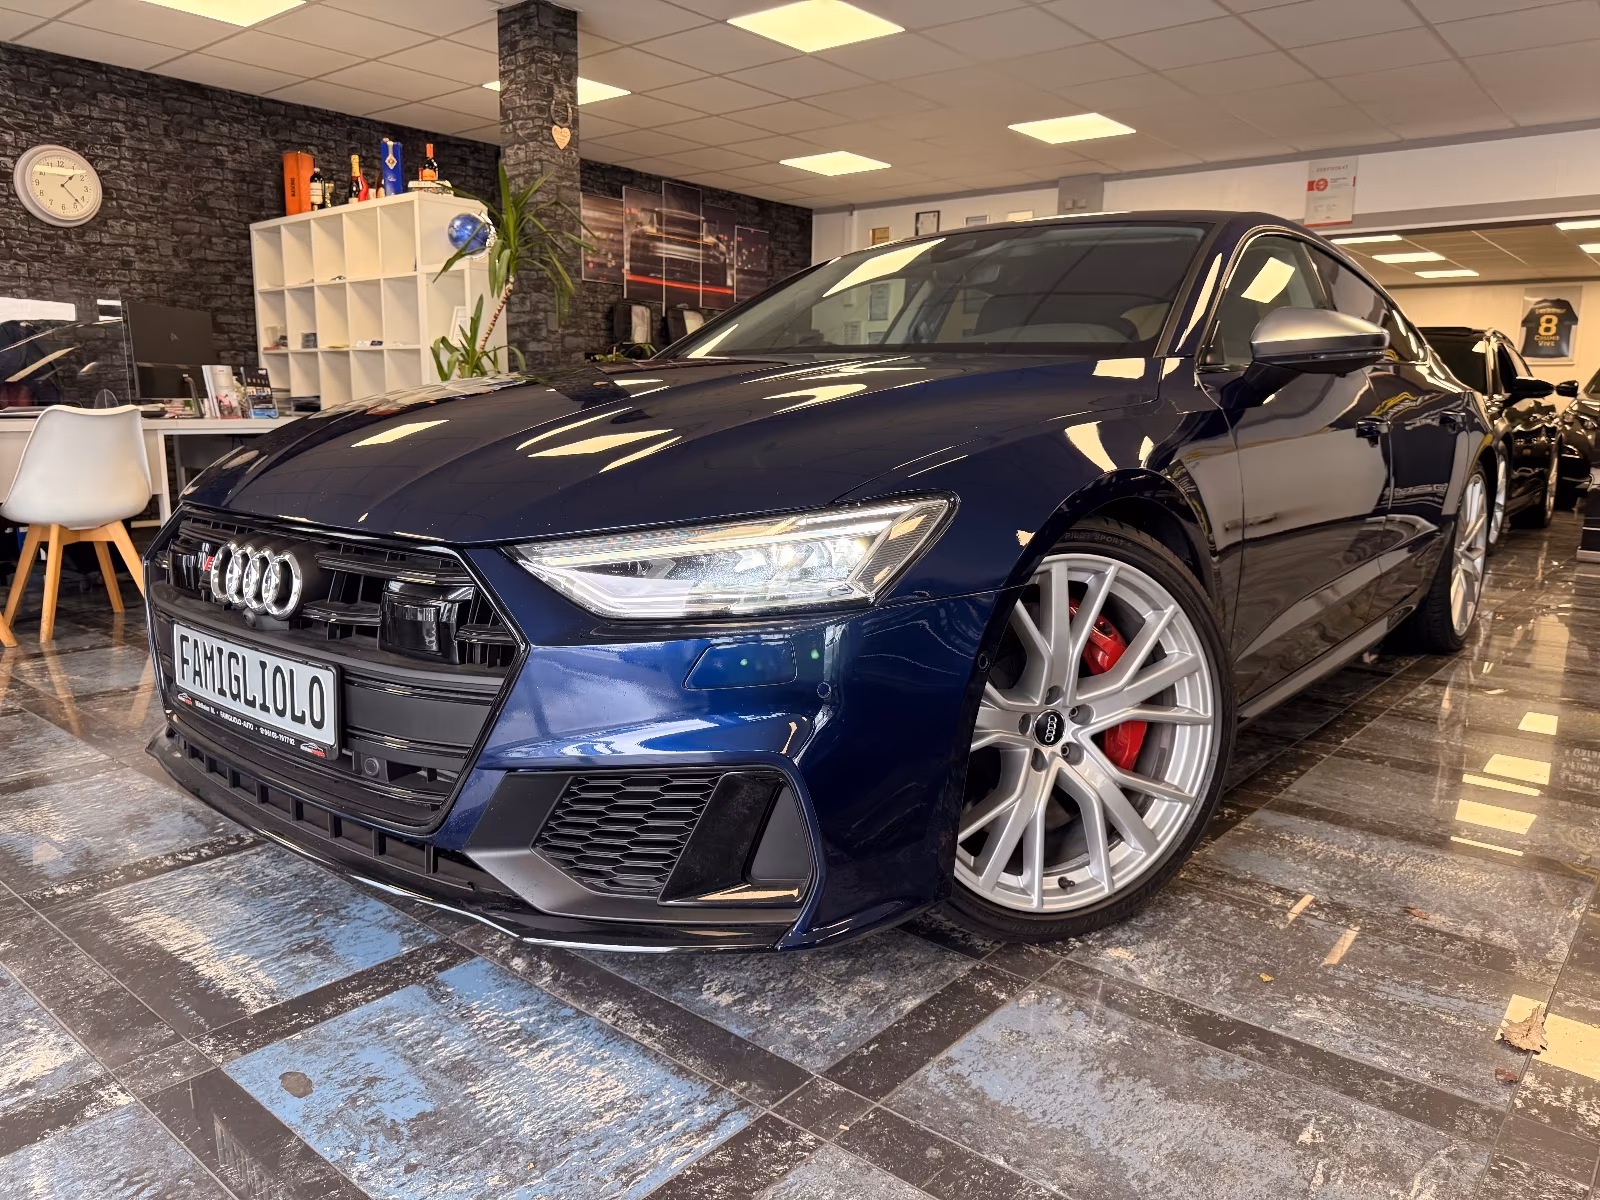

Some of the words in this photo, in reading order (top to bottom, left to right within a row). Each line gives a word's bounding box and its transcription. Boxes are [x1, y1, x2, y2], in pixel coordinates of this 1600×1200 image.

[1538, 314, 1558, 336] 8
[1094, 533, 1124, 546] SPORT
[180, 634, 326, 730] FAMIGLIOLO
